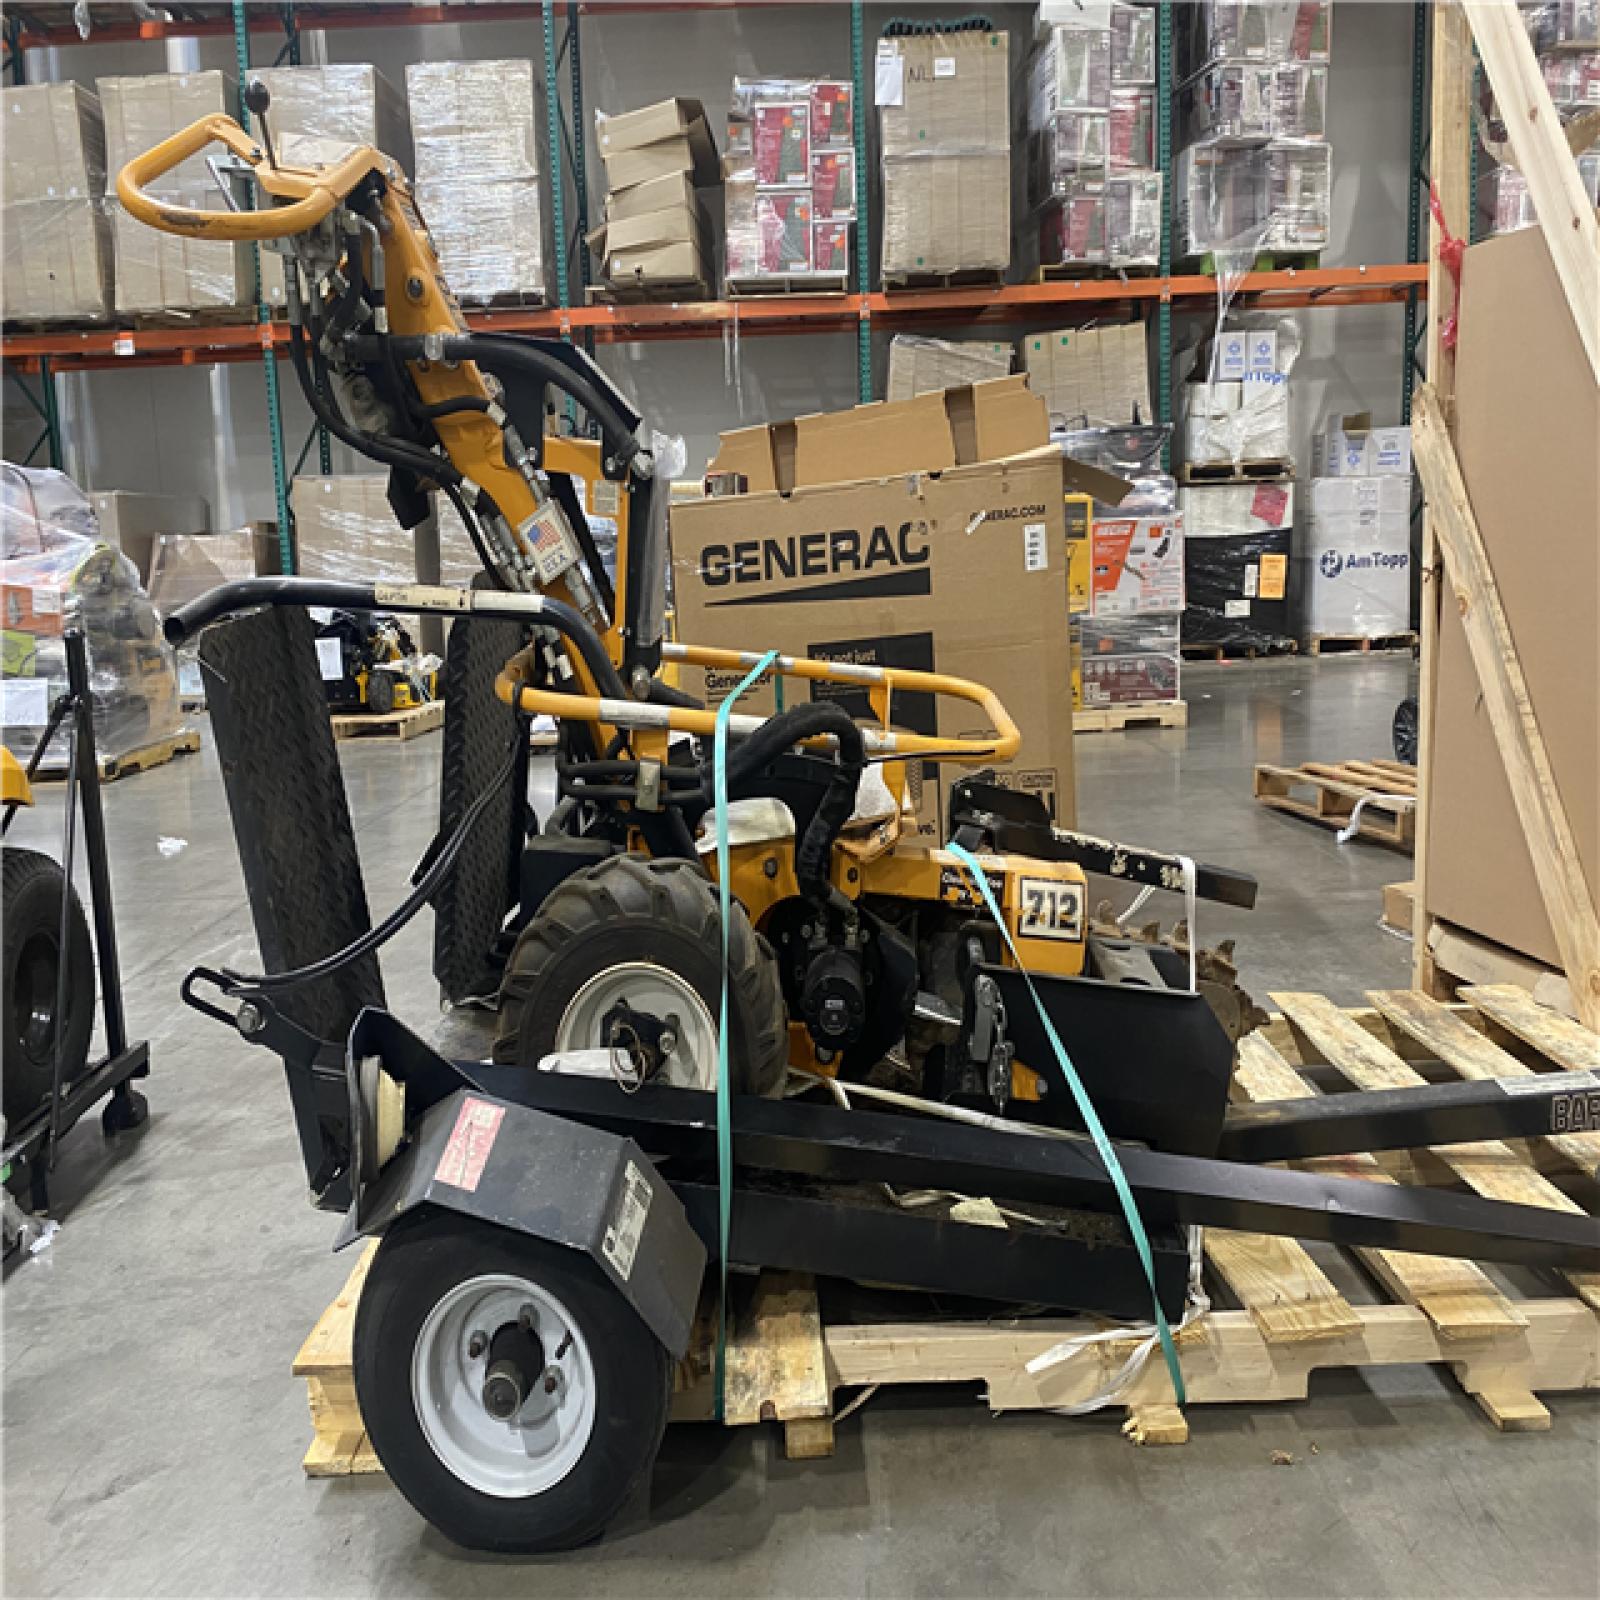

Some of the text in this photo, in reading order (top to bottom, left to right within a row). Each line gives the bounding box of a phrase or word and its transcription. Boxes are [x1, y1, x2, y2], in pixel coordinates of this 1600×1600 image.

[701, 521, 930, 586] GENERAC
[1345, 551, 1408, 570] AmTopp
[1027, 889, 1079, 930] 712
